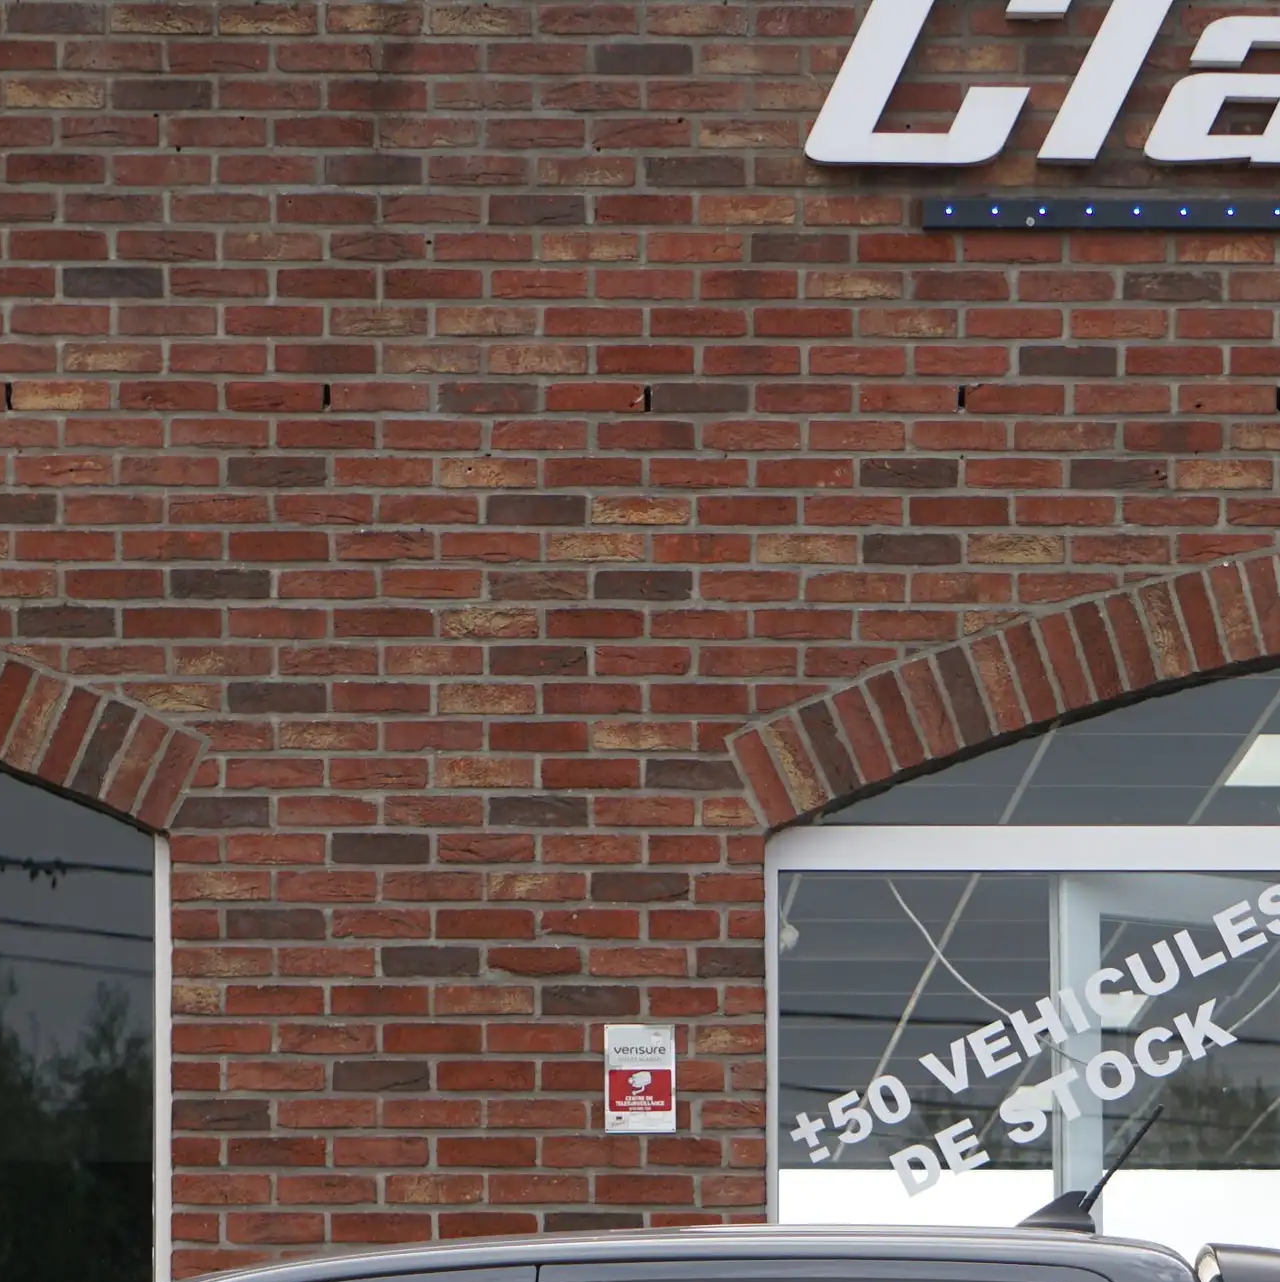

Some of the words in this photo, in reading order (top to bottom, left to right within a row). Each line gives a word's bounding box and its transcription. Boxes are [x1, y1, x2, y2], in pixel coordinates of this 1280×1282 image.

[614, 1045, 666, 1055] verisure
[889, 1117, 992, 1199] DE
[999, 996, 1238, 1145] STOCK
